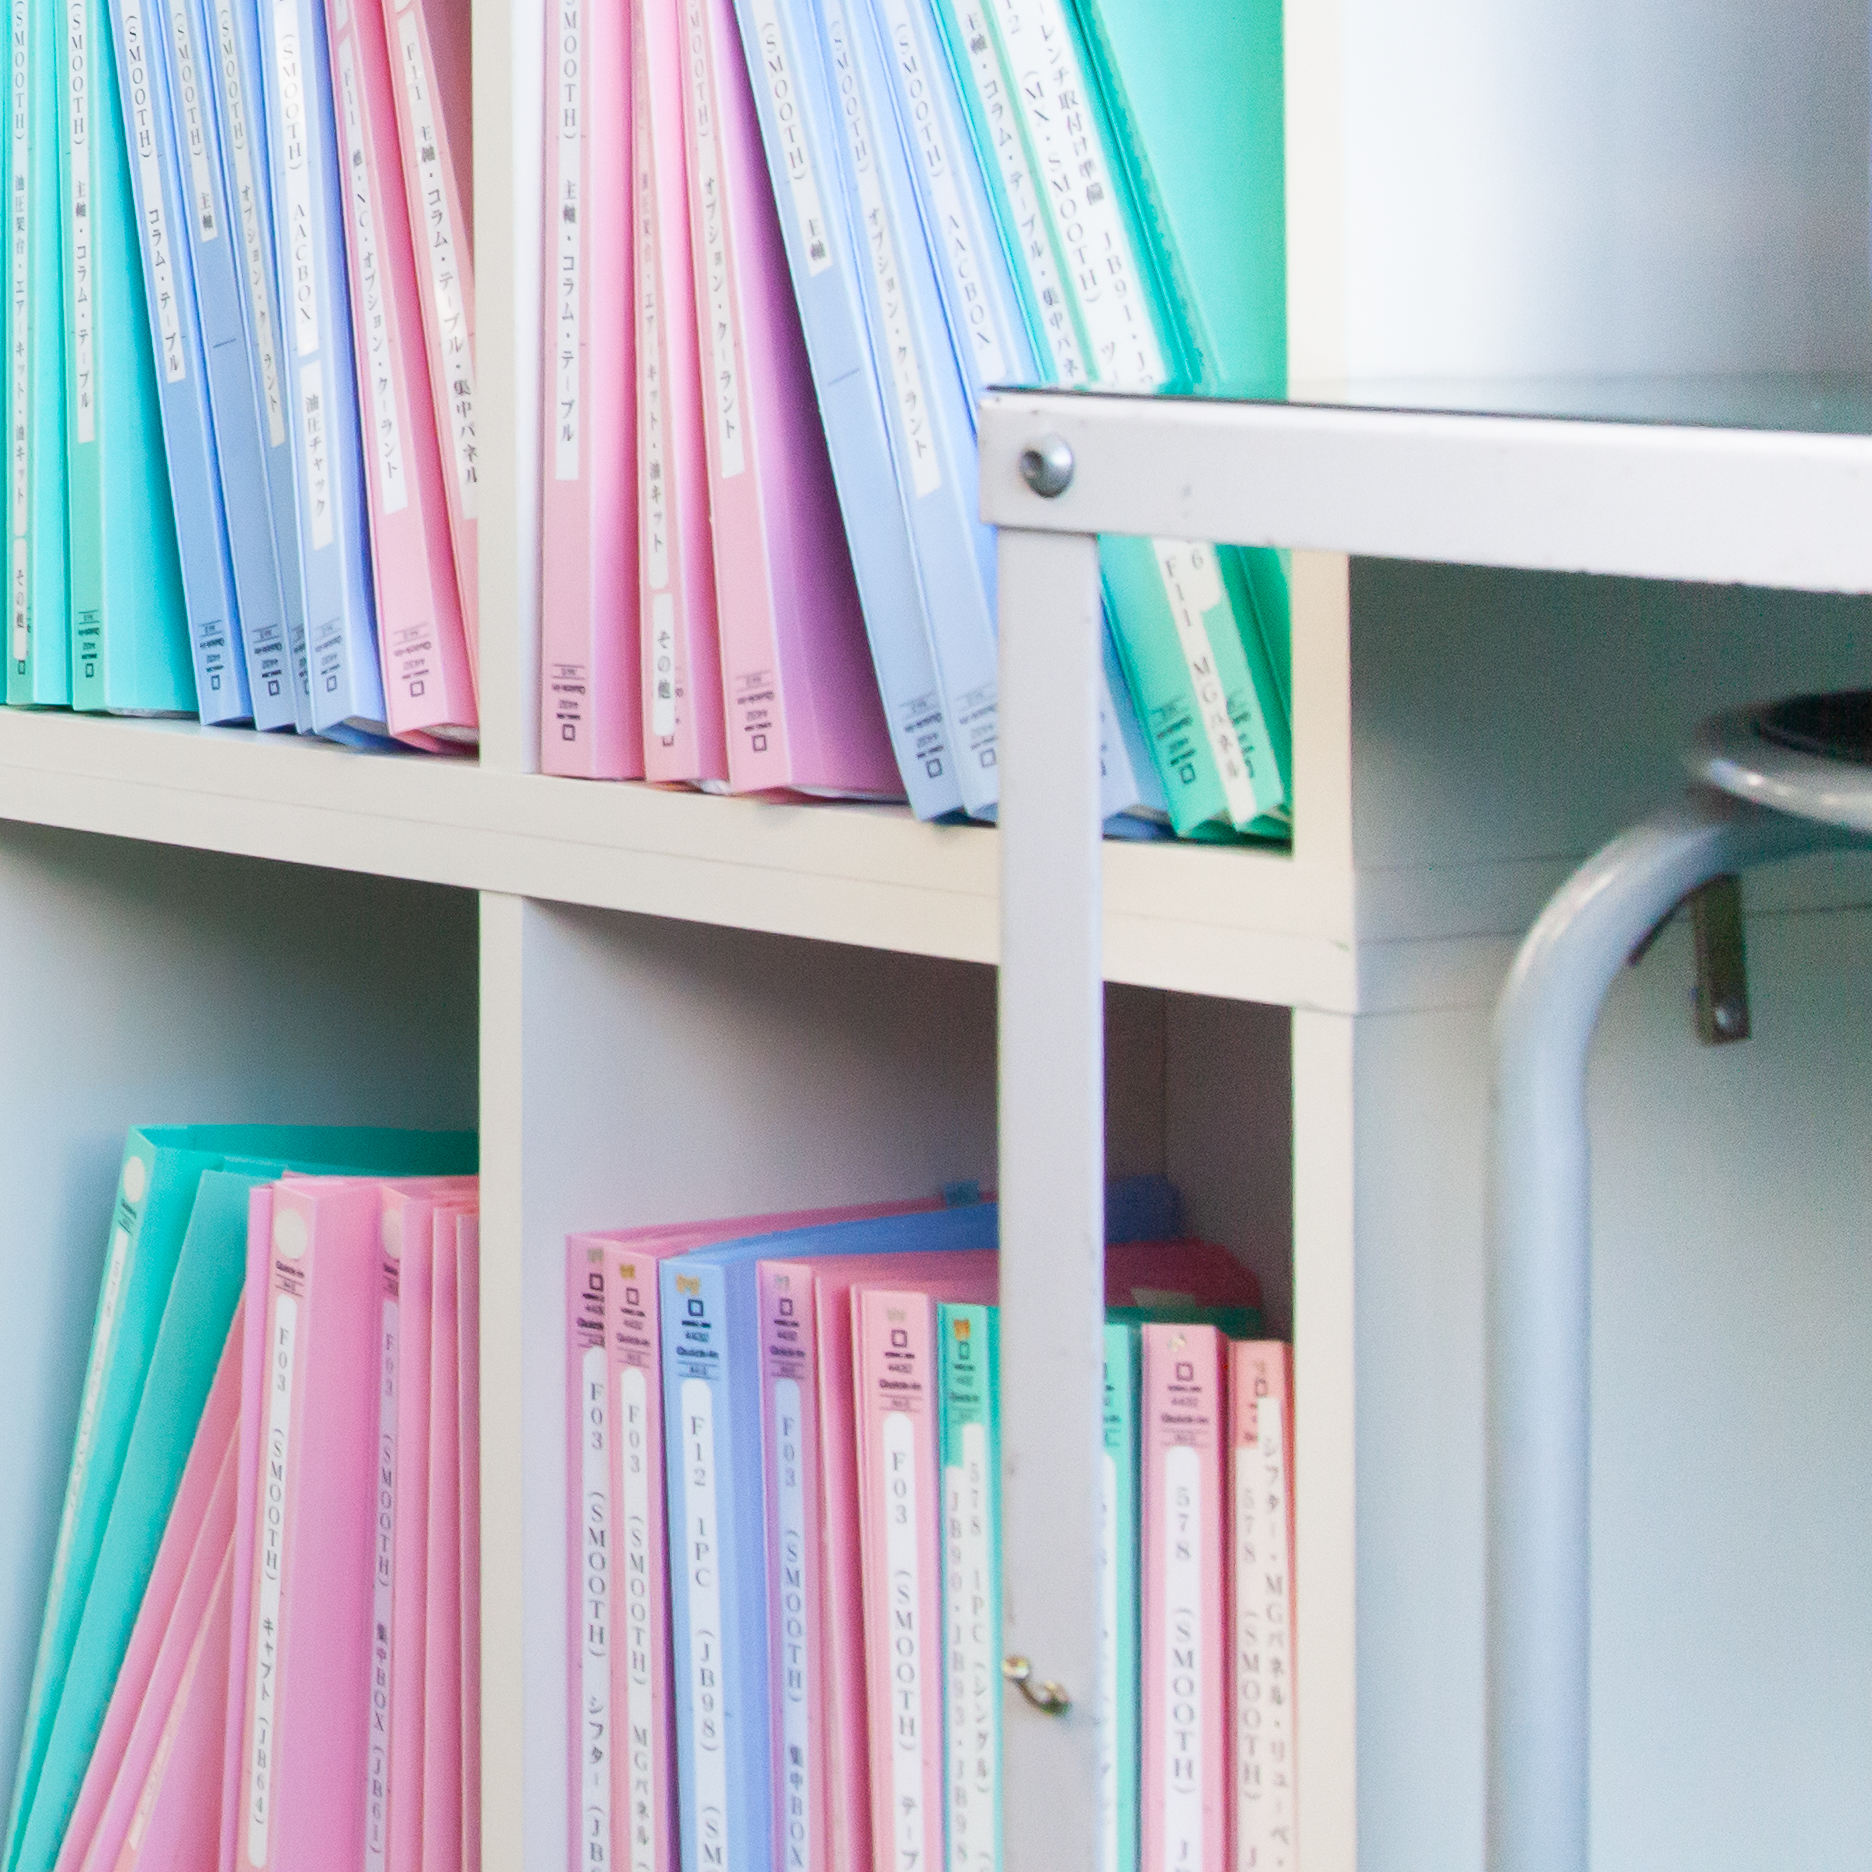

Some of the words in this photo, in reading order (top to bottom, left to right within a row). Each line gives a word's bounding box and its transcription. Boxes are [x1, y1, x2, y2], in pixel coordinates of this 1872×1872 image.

[13, 0, 27, 141] (SMOOTH)
[70, 2, 86, 146] (SMOOTH)
[124, 14, 154, 159] (SMOOTH)
[173, 12, 203, 157] (SMOOTH)
[220, 9, 244, 151] (SMOOTH)
[762, 21, 807, 180] (SMOOTH)
[894, 22, 945, 178] (SMOOTH)
[281, 33, 302, 170] (SMOOTH)
[293, 205, 313, 321] AACBOX
[276, 1327, 289, 1395] F03
[589, 1381, 605, 1449] F03
[265, 1427, 286, 1582] (SMOOTH)
[690, 1415, 707, 1487] F12
[892, 1451, 908, 1525] F03
[587, 1491, 608, 1658] (SMOOTH)
[628, 1515, 650, 1686] (SMOOTH)
[784, 1528, 804, 1704] (SMOOTH)
[895, 1569, 916, 1752] (SMOOTH)
[1173, 1607, 1195, 1796] (SMOOTH)
